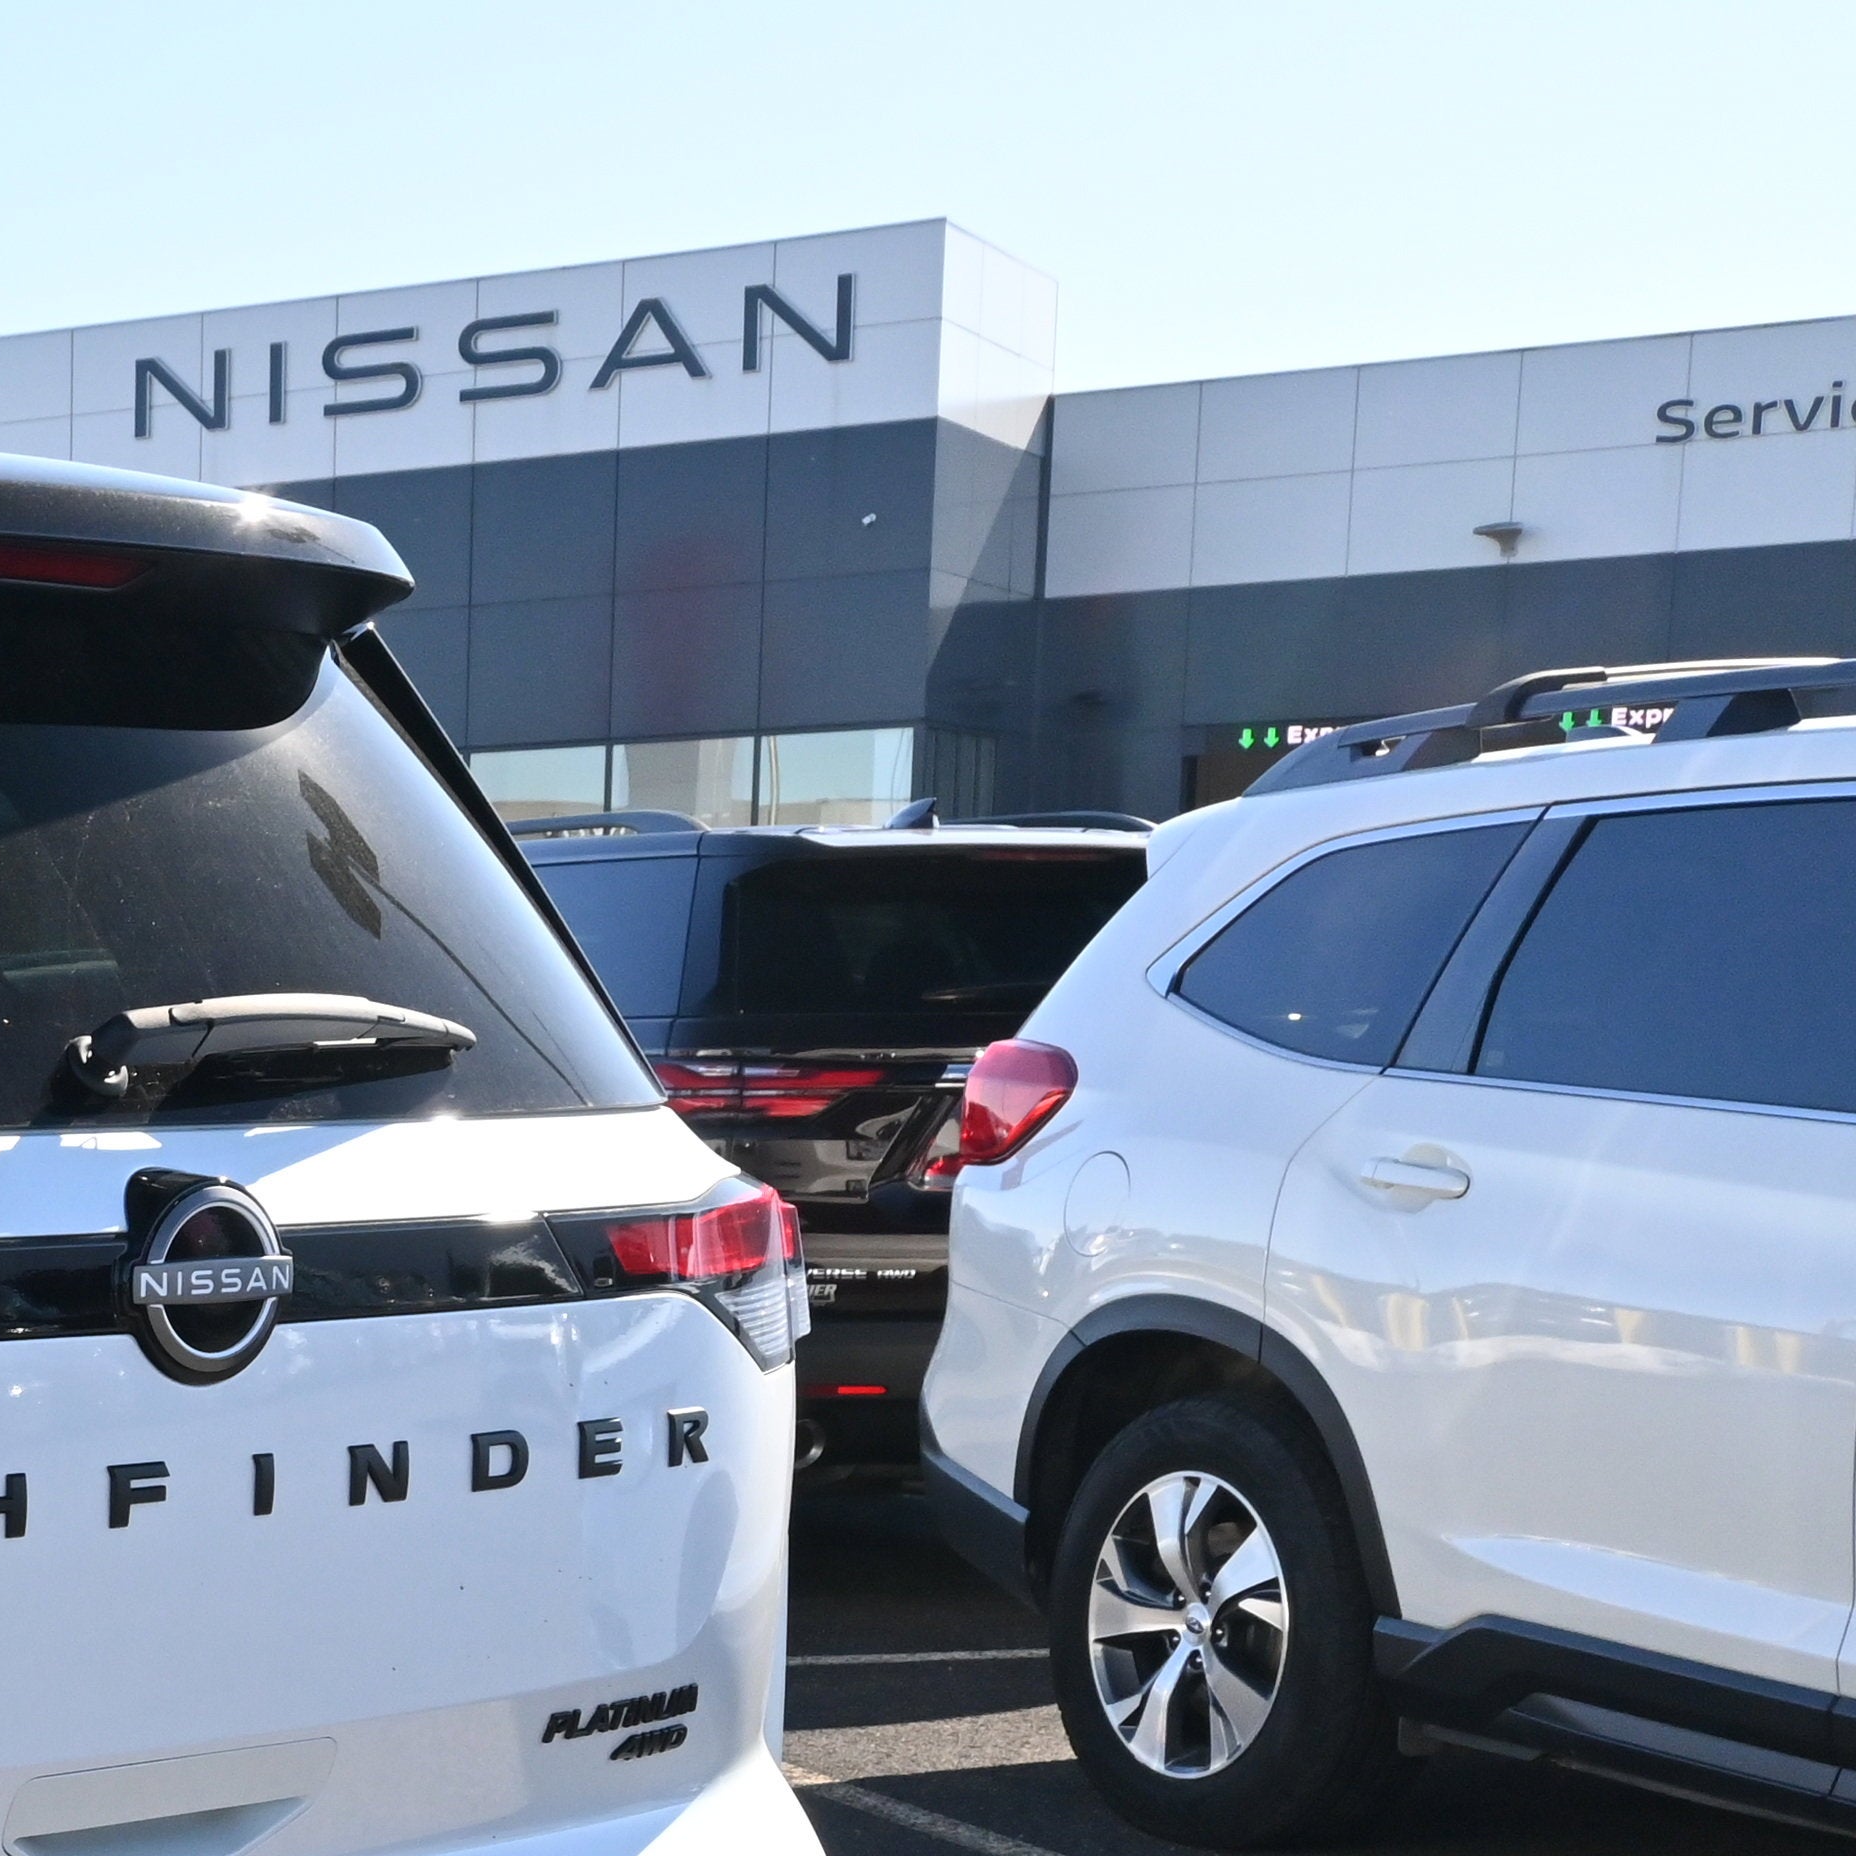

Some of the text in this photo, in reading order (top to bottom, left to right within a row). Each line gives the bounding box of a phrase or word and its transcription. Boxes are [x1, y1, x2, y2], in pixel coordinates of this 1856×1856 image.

[134, 273, 856, 440] NISSAN
[1655, 380, 1856, 443] Servi
[140, 1265, 289, 1298] NISSAN
[541, 1682, 699, 1743] PLATINUM
